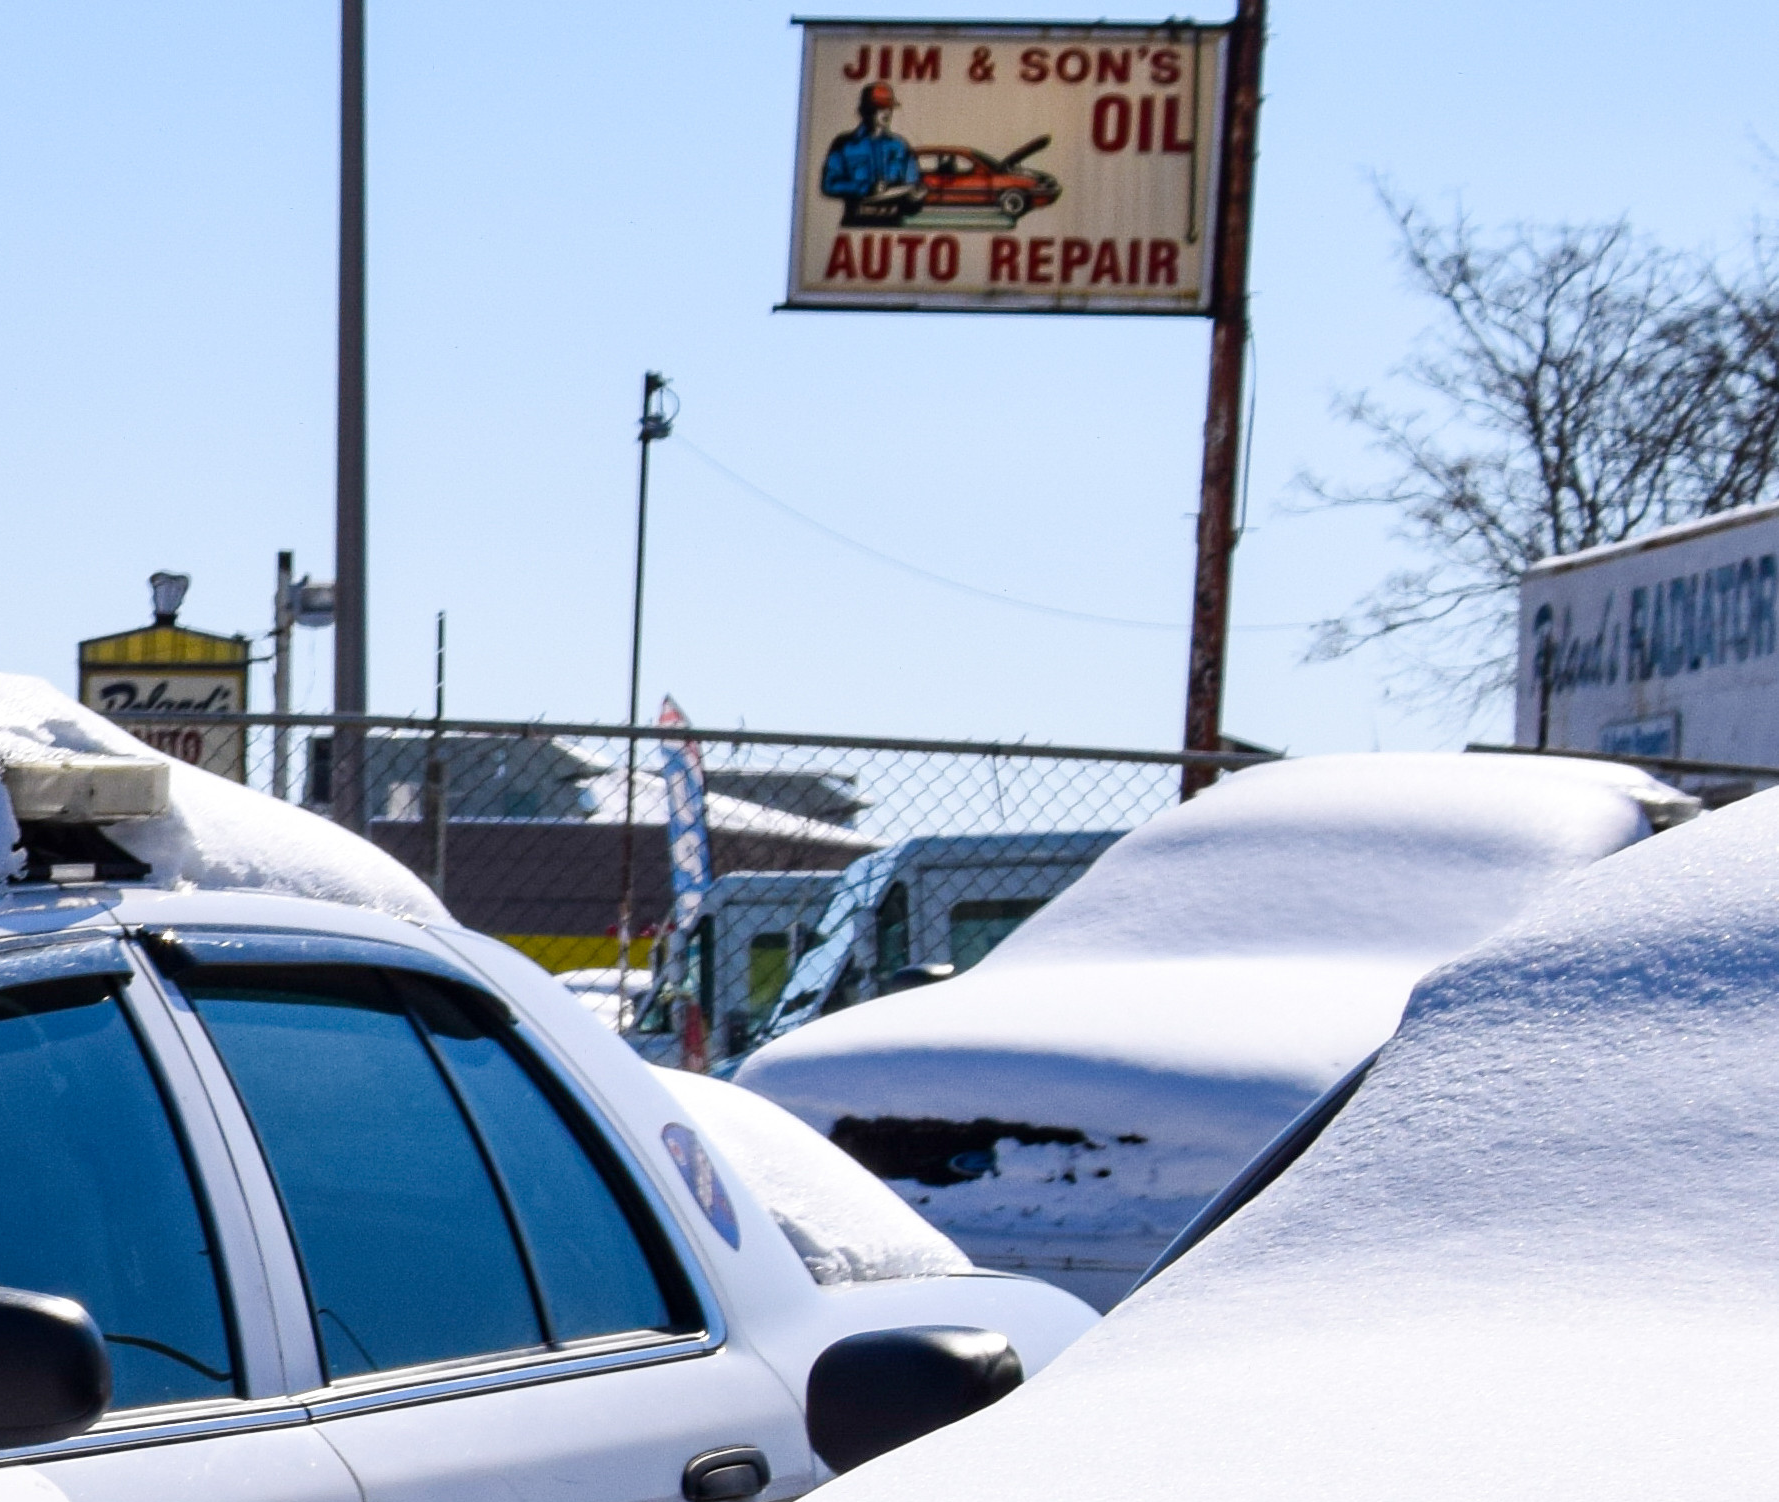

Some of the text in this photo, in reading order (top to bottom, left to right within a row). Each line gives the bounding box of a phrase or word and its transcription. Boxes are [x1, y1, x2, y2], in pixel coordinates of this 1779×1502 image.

[843, 44, 1182, 85] JIM & SON'S
[1092, 93, 1195, 154] OIL
[825, 234, 1180, 286] AUTO REPAIR
